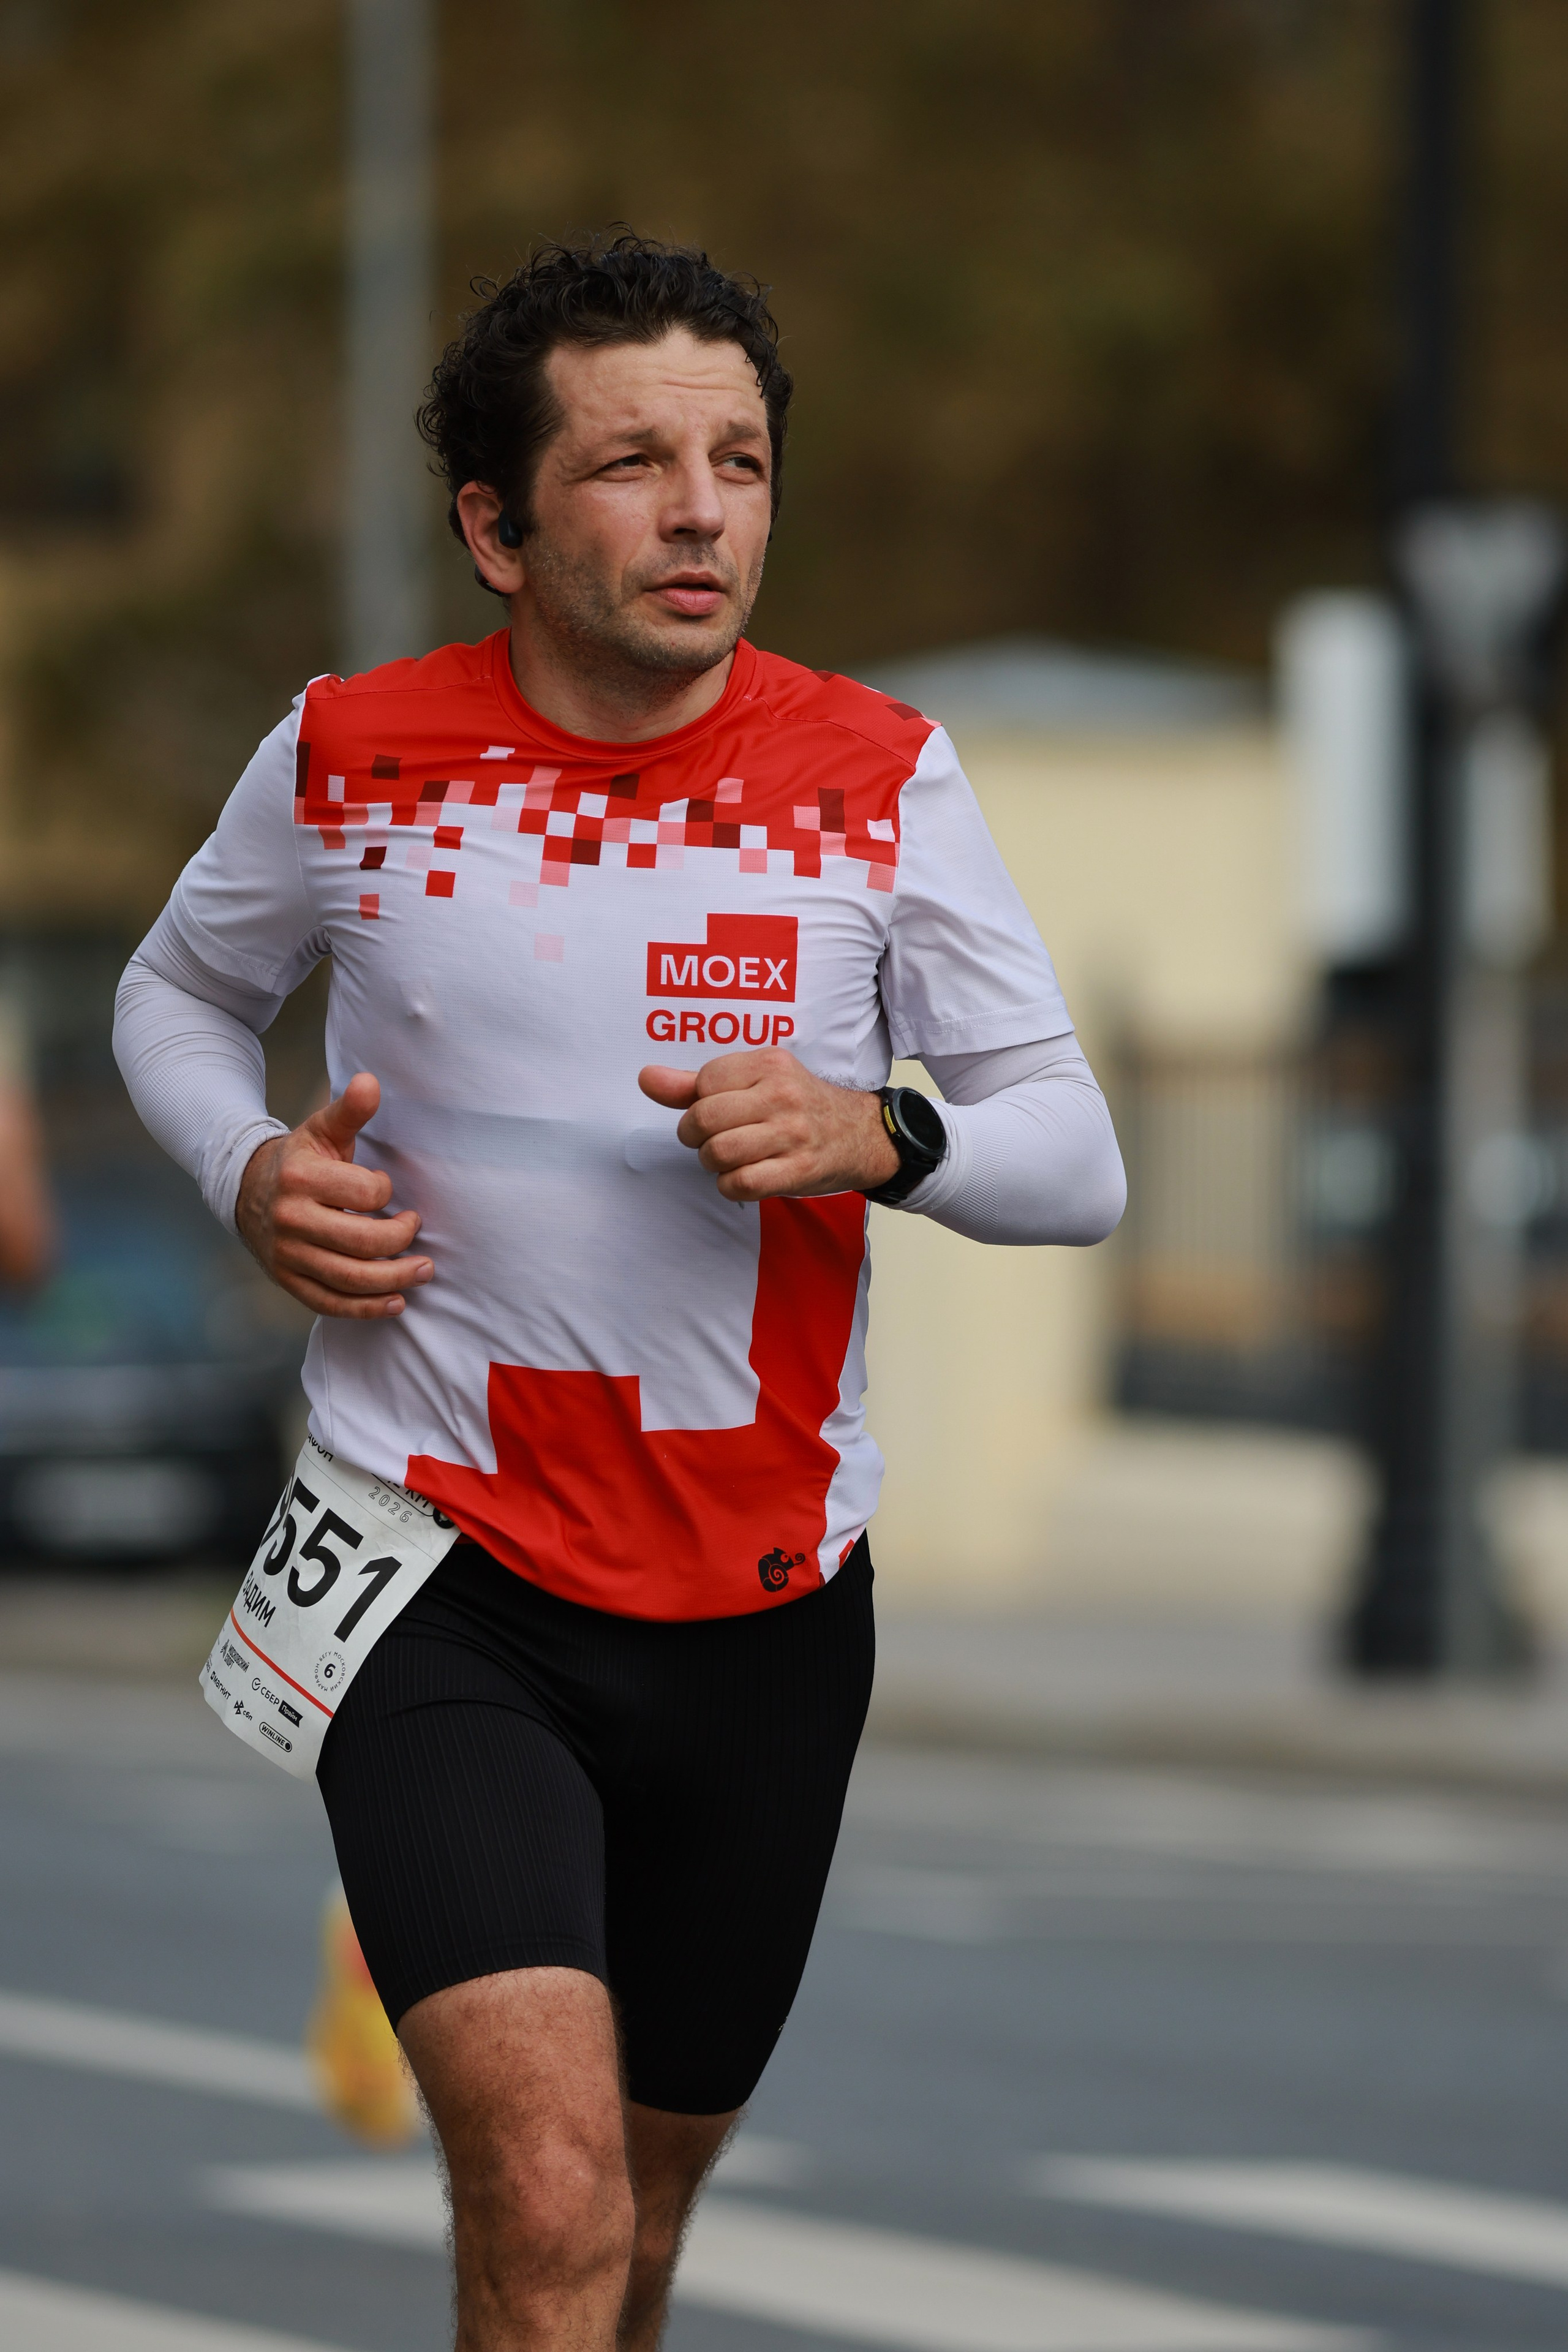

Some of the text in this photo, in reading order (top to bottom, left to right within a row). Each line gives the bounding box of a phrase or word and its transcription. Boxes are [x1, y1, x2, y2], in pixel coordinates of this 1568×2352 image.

[660, 954, 788, 990] MOEX
[646, 1009, 794, 1046] GROUP
[368, 1486, 413, 1523] 2026
[243, 1570, 276, 1628] ВАДИМ
[314, 1651, 346, 1692] БЕГУ МОСКОВСКИЙ МАРАФОН
[324, 1663, 336, 1679] 6
[243, 1709, 253, 1721] сбп
[260, 1686, 298, 1721] СБЕР Прайм
[261, 1724, 285, 1746] WINLINE
